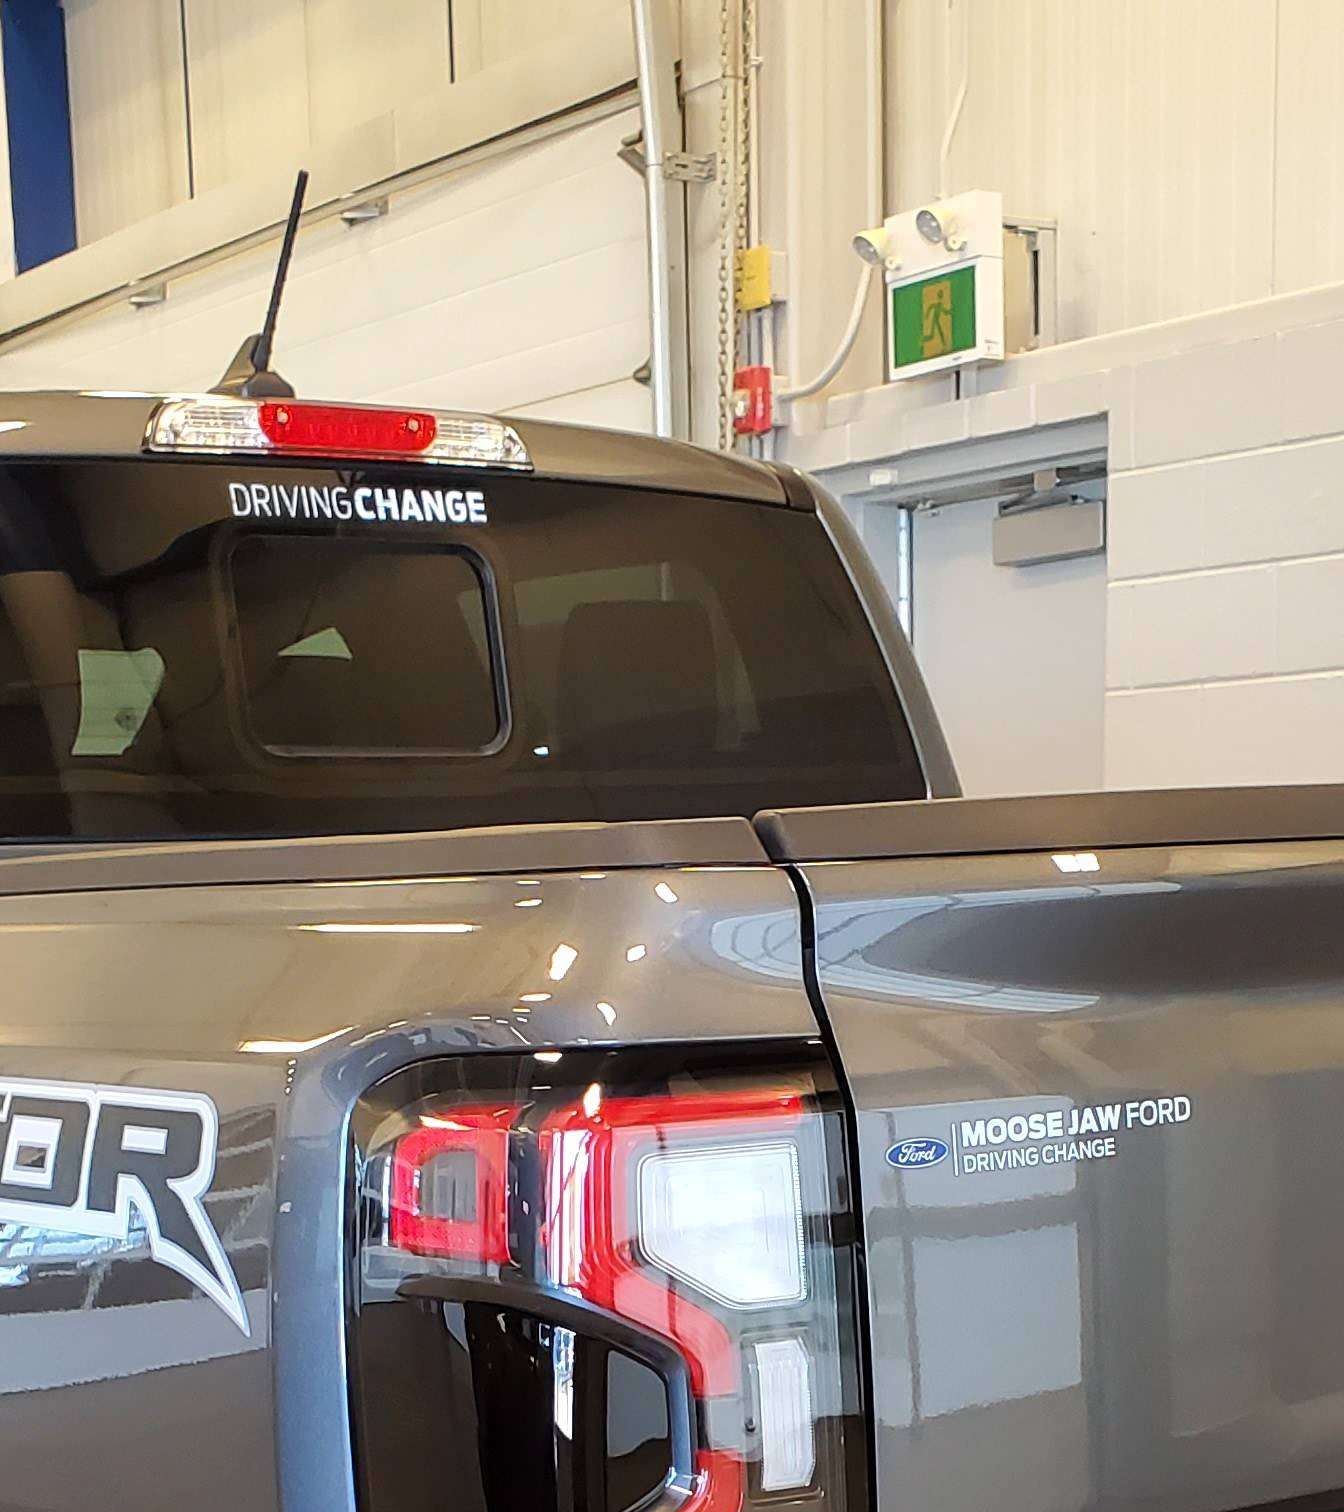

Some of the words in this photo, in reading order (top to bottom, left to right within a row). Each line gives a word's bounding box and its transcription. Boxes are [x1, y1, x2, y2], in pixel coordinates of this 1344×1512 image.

[960, 1111, 1064, 1148] MOOSE
[1068, 1104, 1122, 1136] JAW
[1125, 1096, 1191, 1129] FORD
[962, 1146, 1040, 1174] DRIVING
[1041, 1138, 1116, 1165] CHANGE
